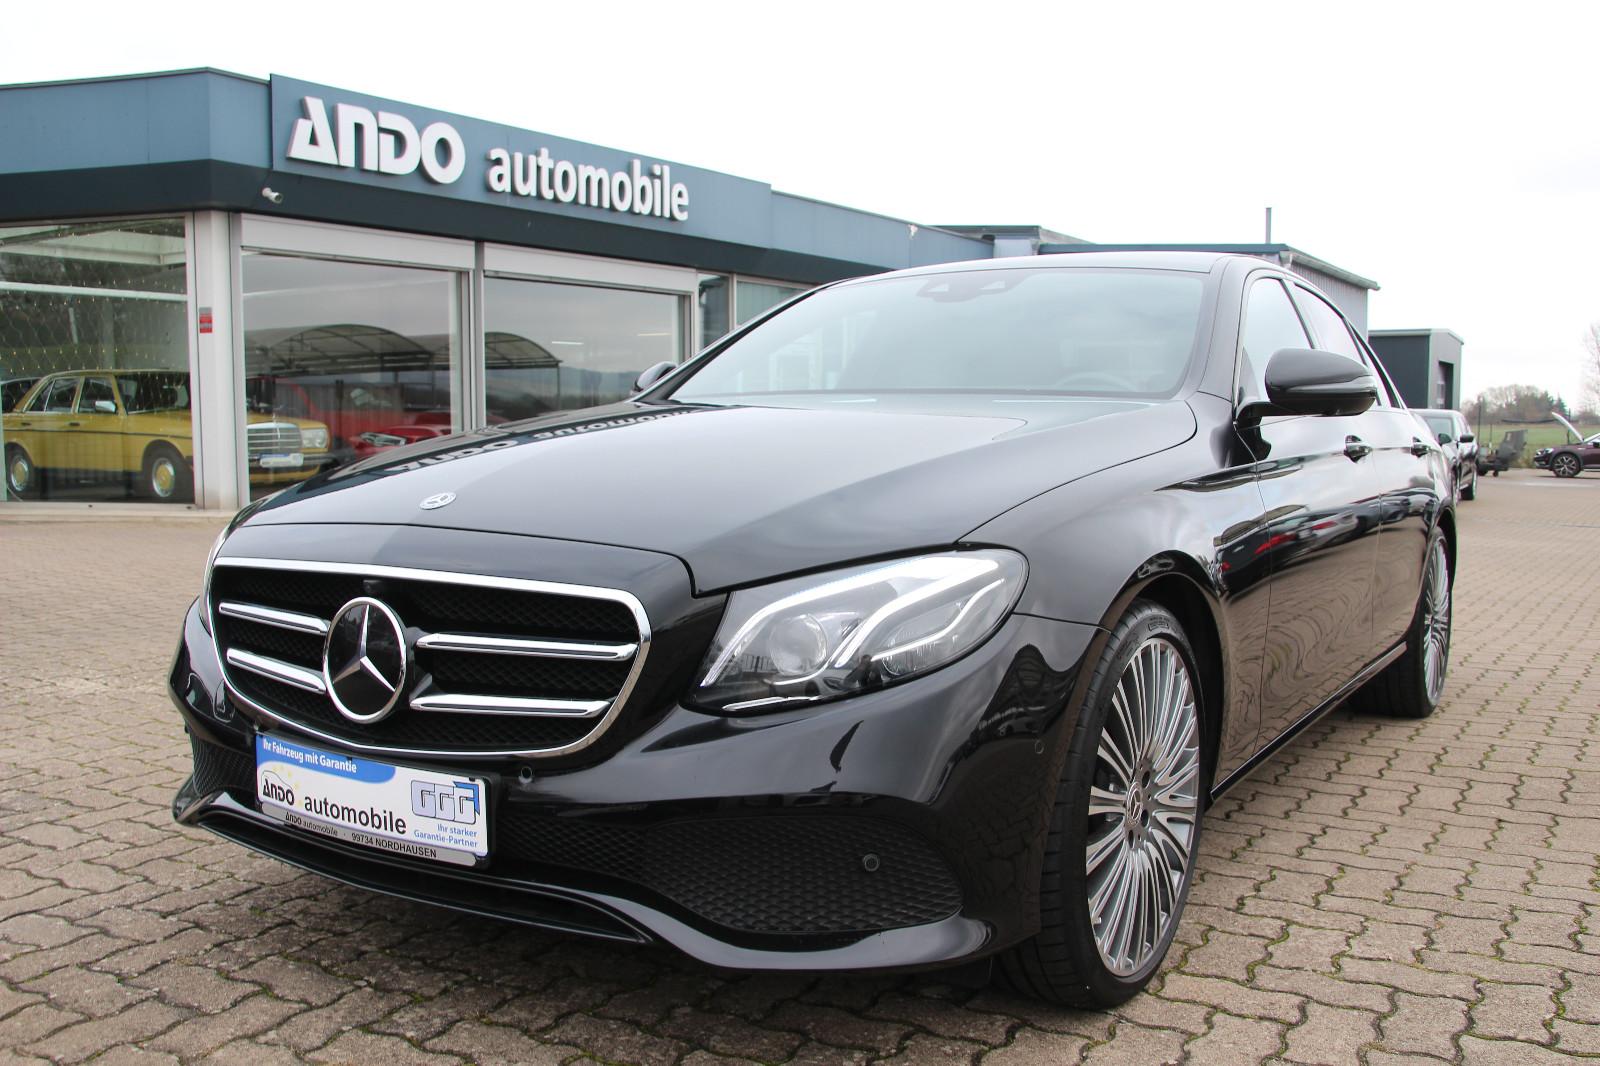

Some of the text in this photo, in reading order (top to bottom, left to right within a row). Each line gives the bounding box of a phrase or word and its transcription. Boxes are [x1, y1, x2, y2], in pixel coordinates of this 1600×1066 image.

[286, 96, 689, 221] ANDO automobile
[263, 738, 357, 773] Ihr Fahrzeug mit Garantie
[304, 796, 407, 835] automobile
[437, 823, 478, 837] Ihr starker
[303, 821, 338, 837] automobile
[351, 832, 374, 845] 99734
[375, 838, 437, 858] NORDHAUSEN
[413, 830, 478, 848] Garantie-Partner
